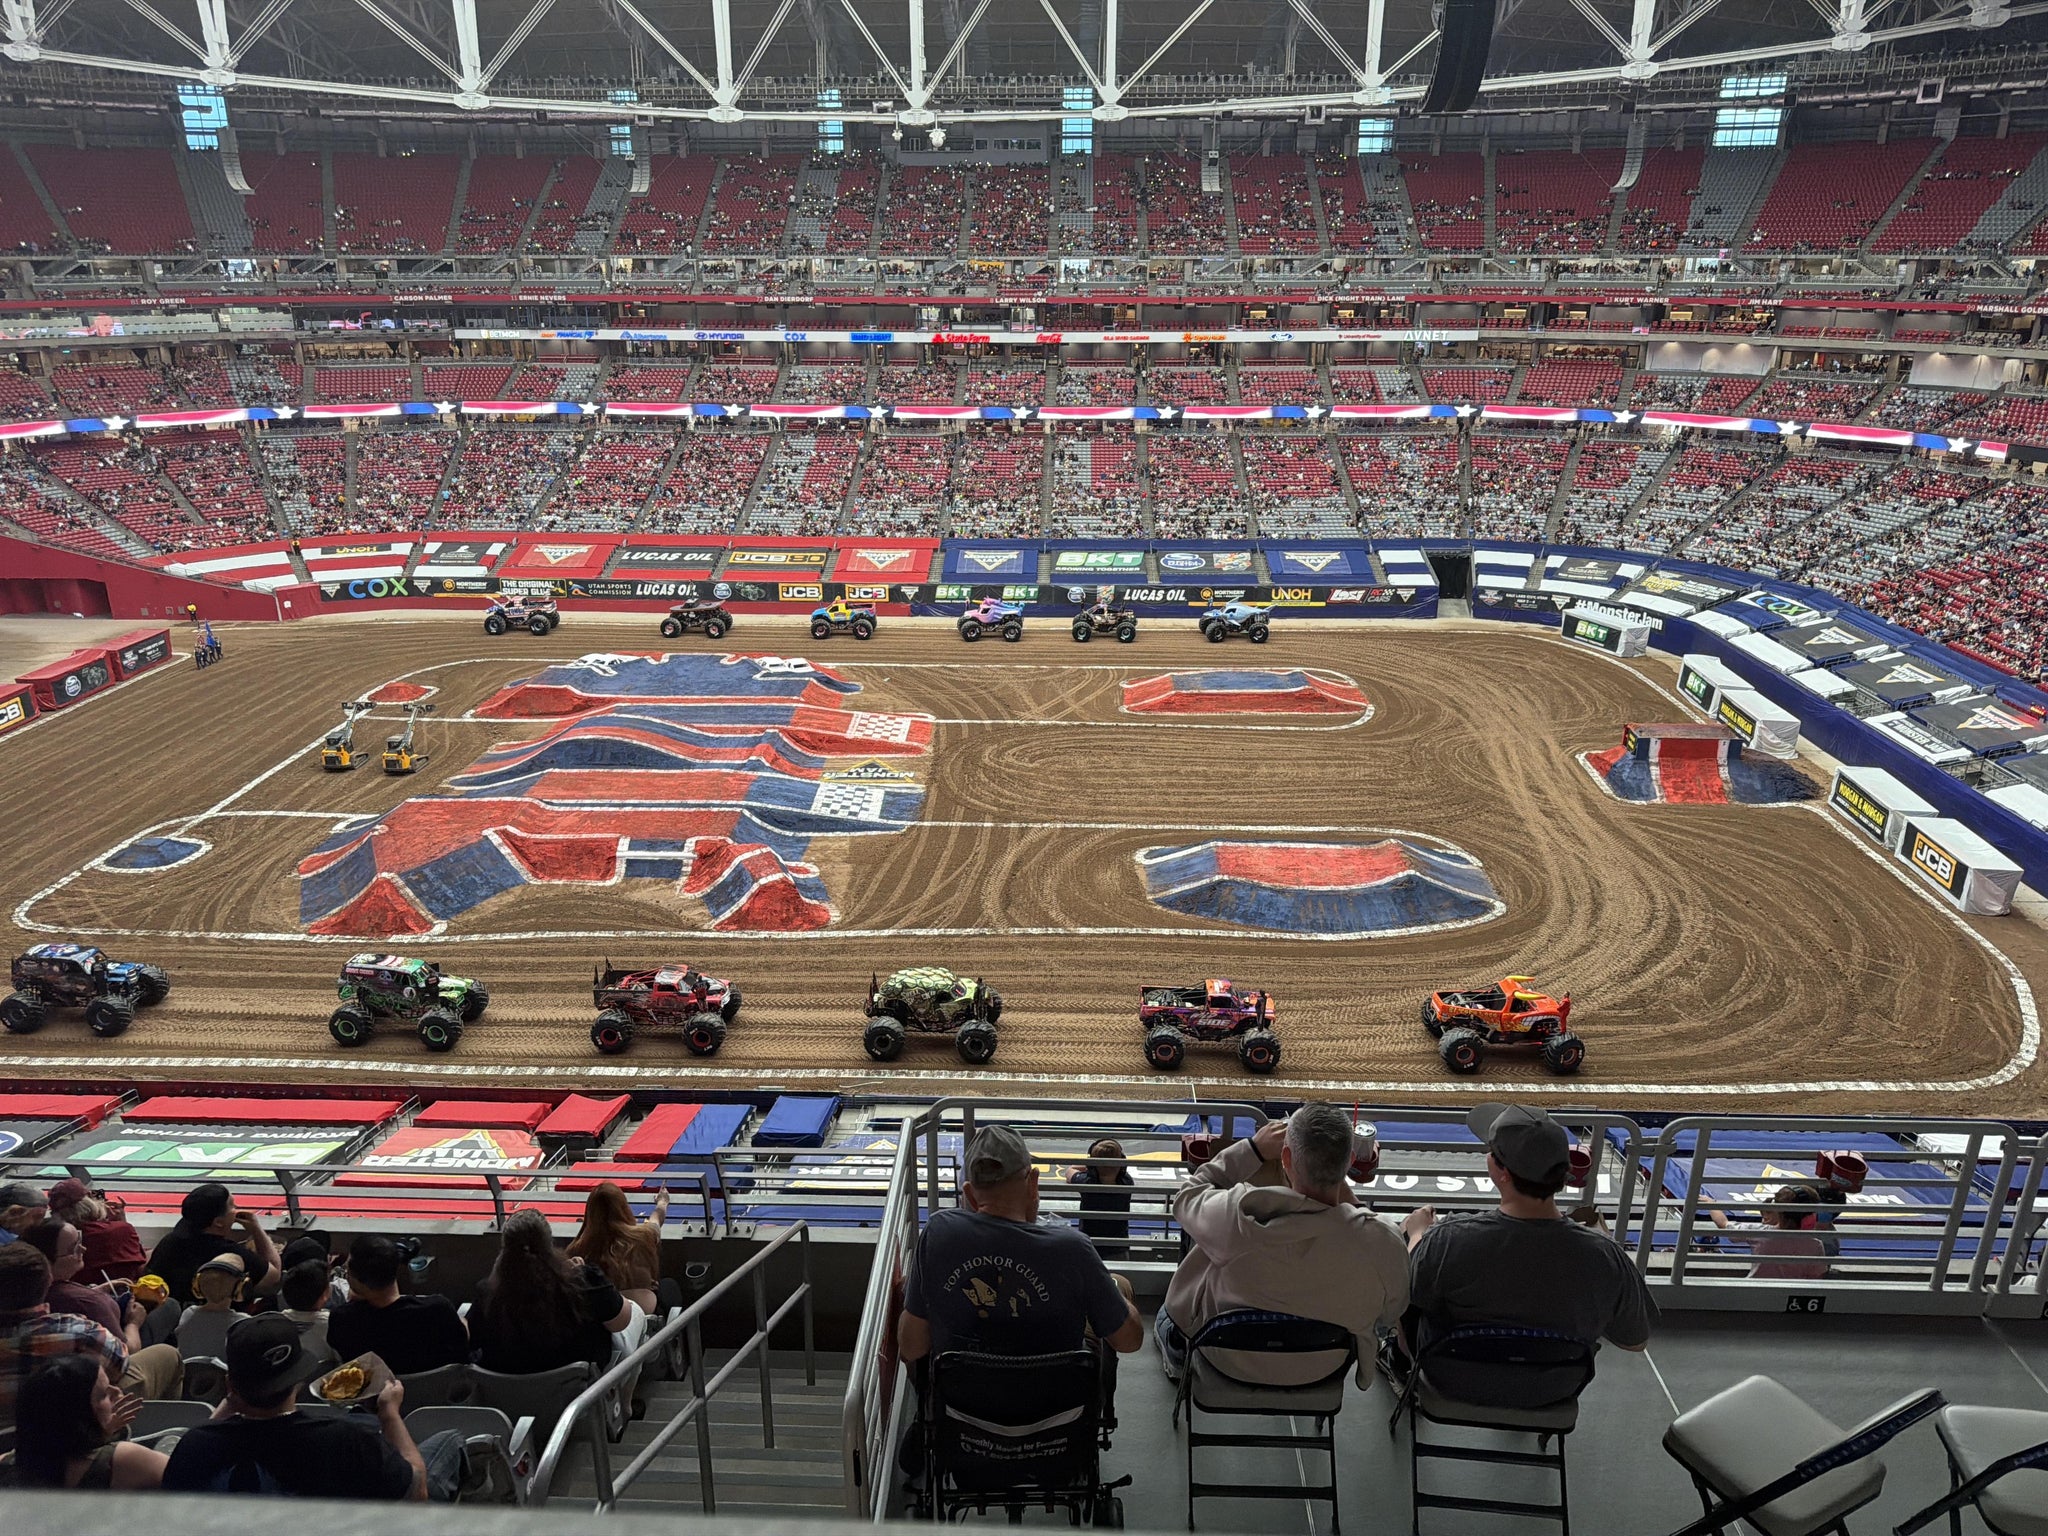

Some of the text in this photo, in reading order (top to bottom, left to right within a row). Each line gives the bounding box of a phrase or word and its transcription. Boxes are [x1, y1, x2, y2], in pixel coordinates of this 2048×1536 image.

[1976, 305, 2019, 313] MARSHALL
[784, 332, 807, 341] COX
[968, 334, 991, 343] Farm
[1404, 330, 1449, 341] AVNET
[621, 552, 713, 561] LUCAS OIL
[735, 553, 788, 562] JCB
[1059, 552, 1142, 565] BKT
[348, 577, 409, 599] COX
[502, 580, 517, 588] THE
[636, 583, 676, 596] LUCAS
[502, 588, 530, 596] SUPER
[782, 586, 820, 598] JCB
[849, 587, 885, 598] JCB
[936, 585, 971, 597] BKT
[1002, 585, 1039, 597] BKT
[1123, 588, 1188, 602] LUCAS OIL
[1271, 588, 1311, 600] UNOH
[1755, 596, 1813, 616] COX
[1575, 599, 1663, 631] #MonsterJam
[1576, 621, 1608, 640] BKT
[1686, 672, 1707, 696] BKT
[1838, 781, 1859, 807] MORGAN
[1862, 801, 1885, 826] MORGAN
[1916, 844, 1952, 881] JCB
[120, 1127, 360, 1139] GROWING TOGETHER
[361, 1155, 536, 1170] MONSTER
[962, 1255, 1014, 1272] HONOR
[1015, 1263, 1050, 1302] GUARD
[1807, 1299, 1819, 1312] 6
